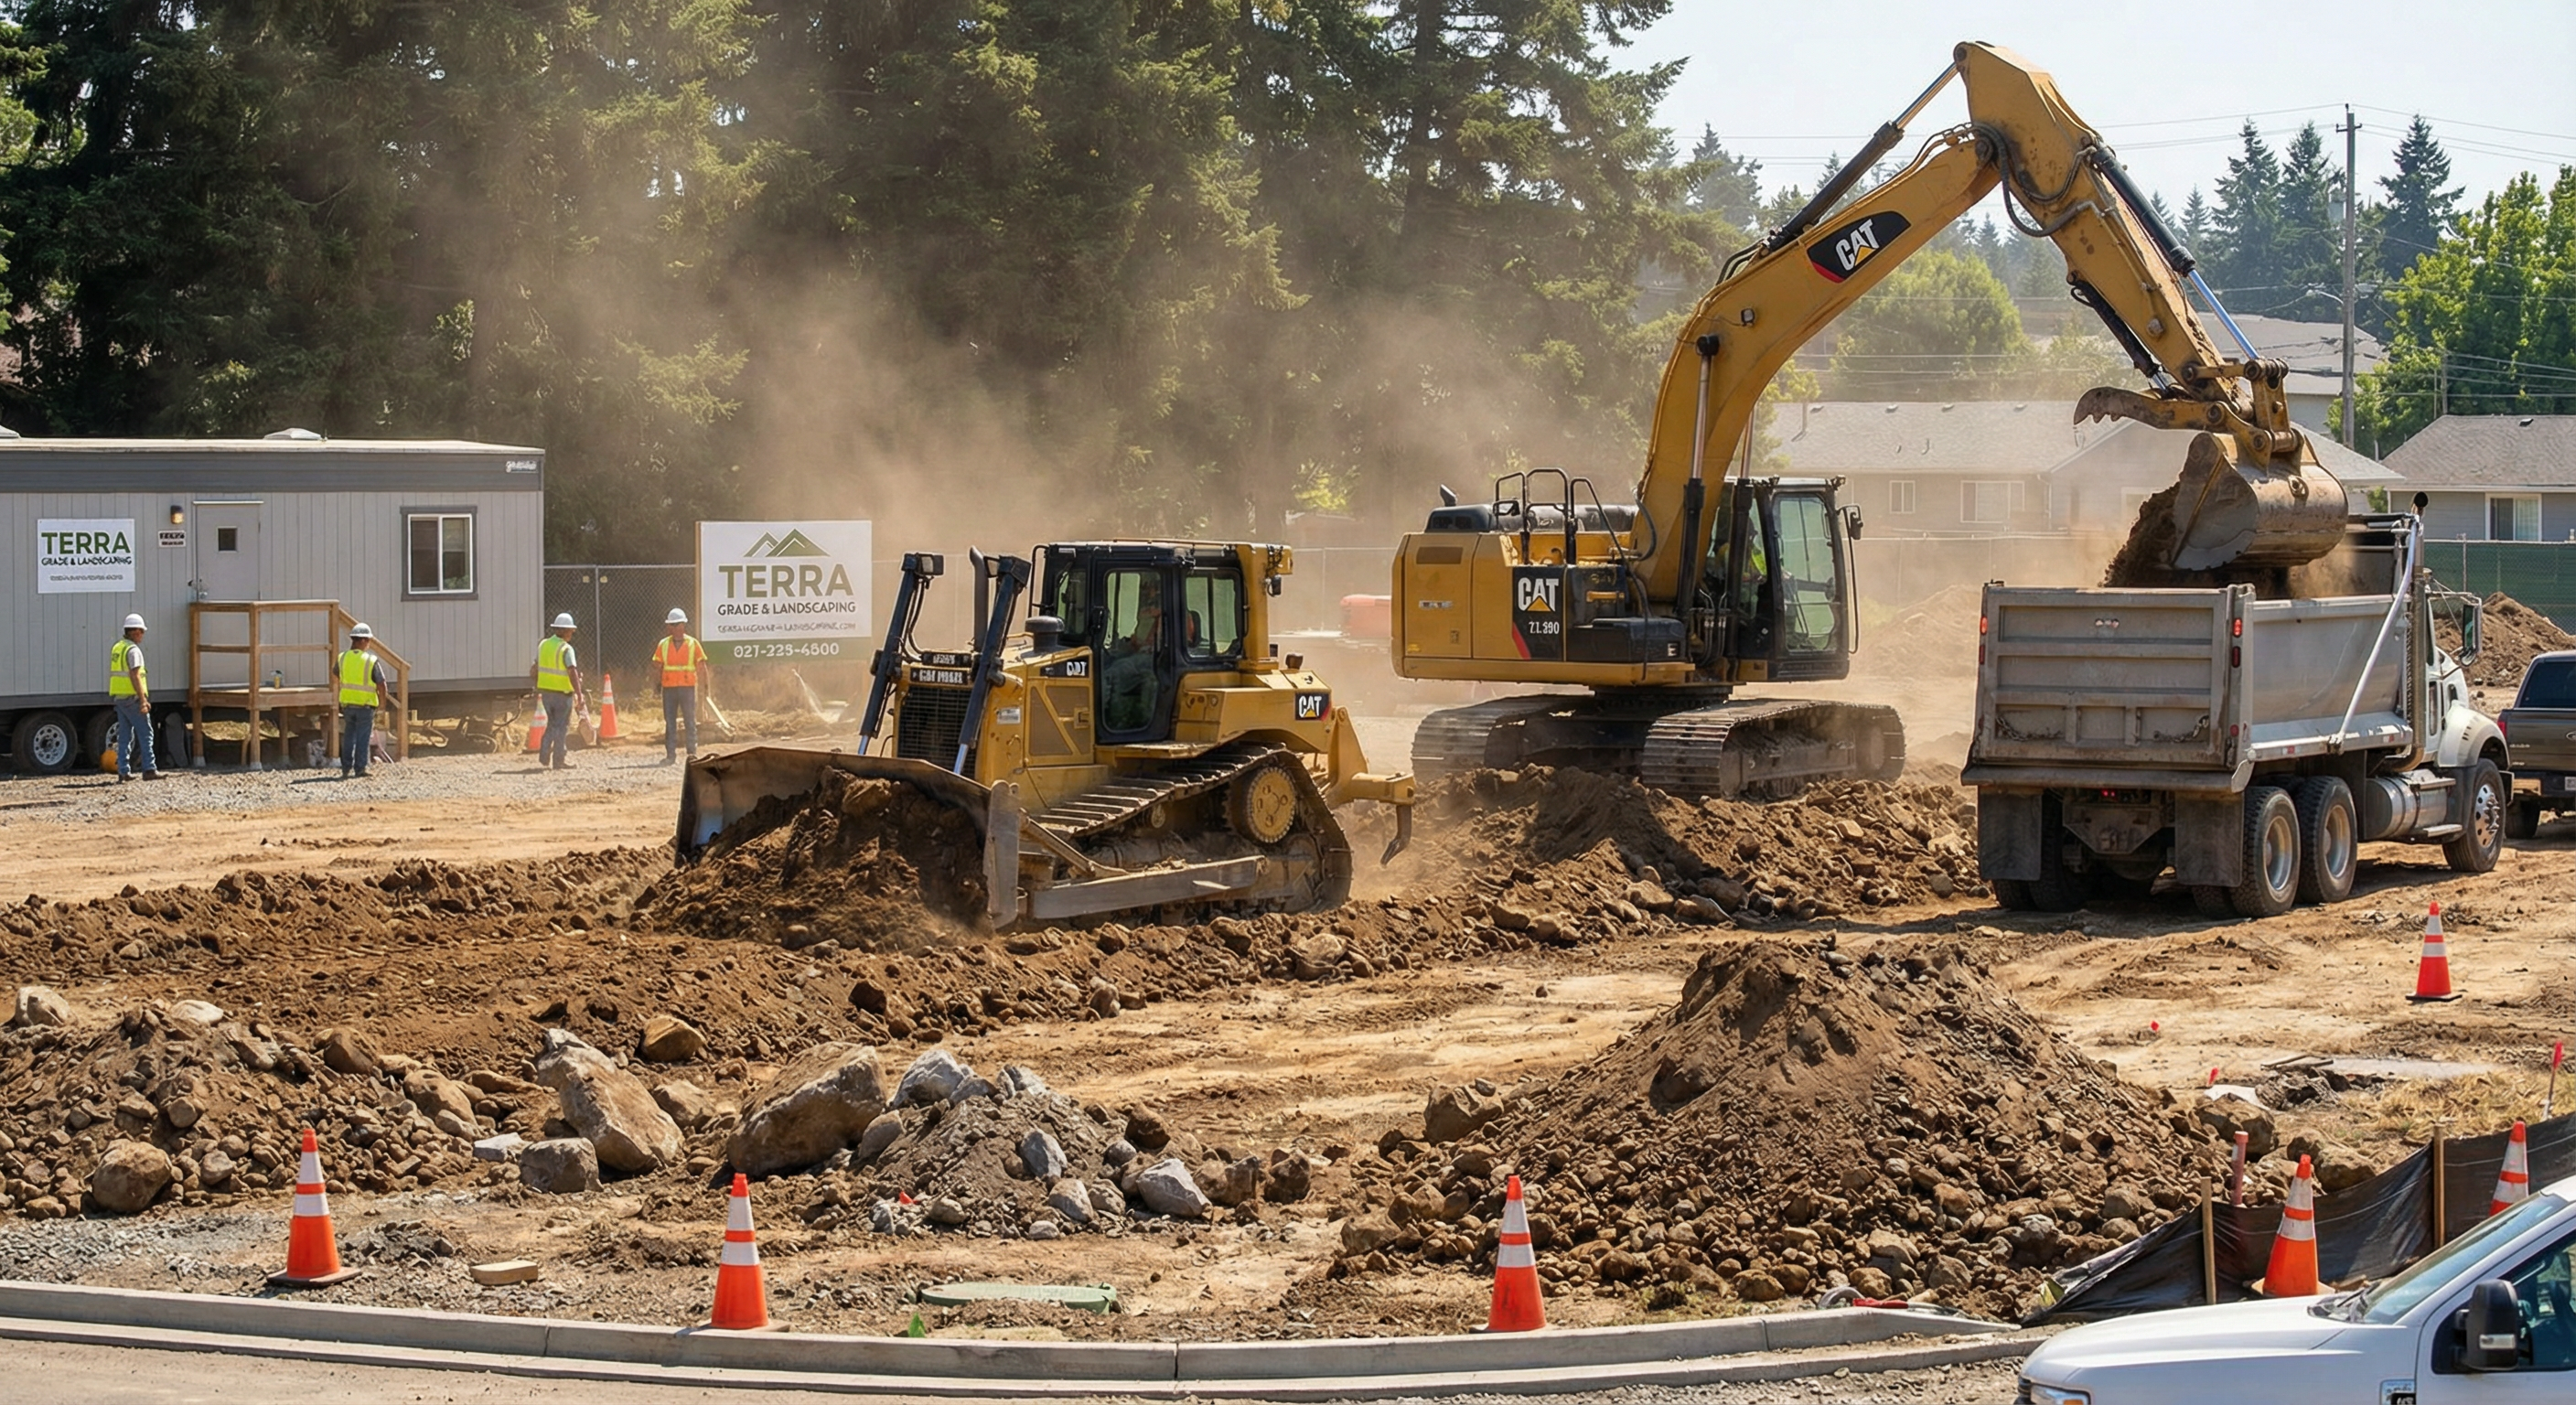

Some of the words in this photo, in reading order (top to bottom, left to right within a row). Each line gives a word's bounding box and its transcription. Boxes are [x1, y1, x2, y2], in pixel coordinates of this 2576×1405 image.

[1835, 219, 1880, 271] CAT
[41, 531, 131, 554] TERRA
[718, 563, 853, 598] TERRA
[1518, 577, 1559, 612] CAT
[717, 604, 758, 616] GRADE
[761, 604, 769, 615] &
[773, 602, 856, 614] LANDSCAPING
[1298, 695, 1322, 718] CAT
